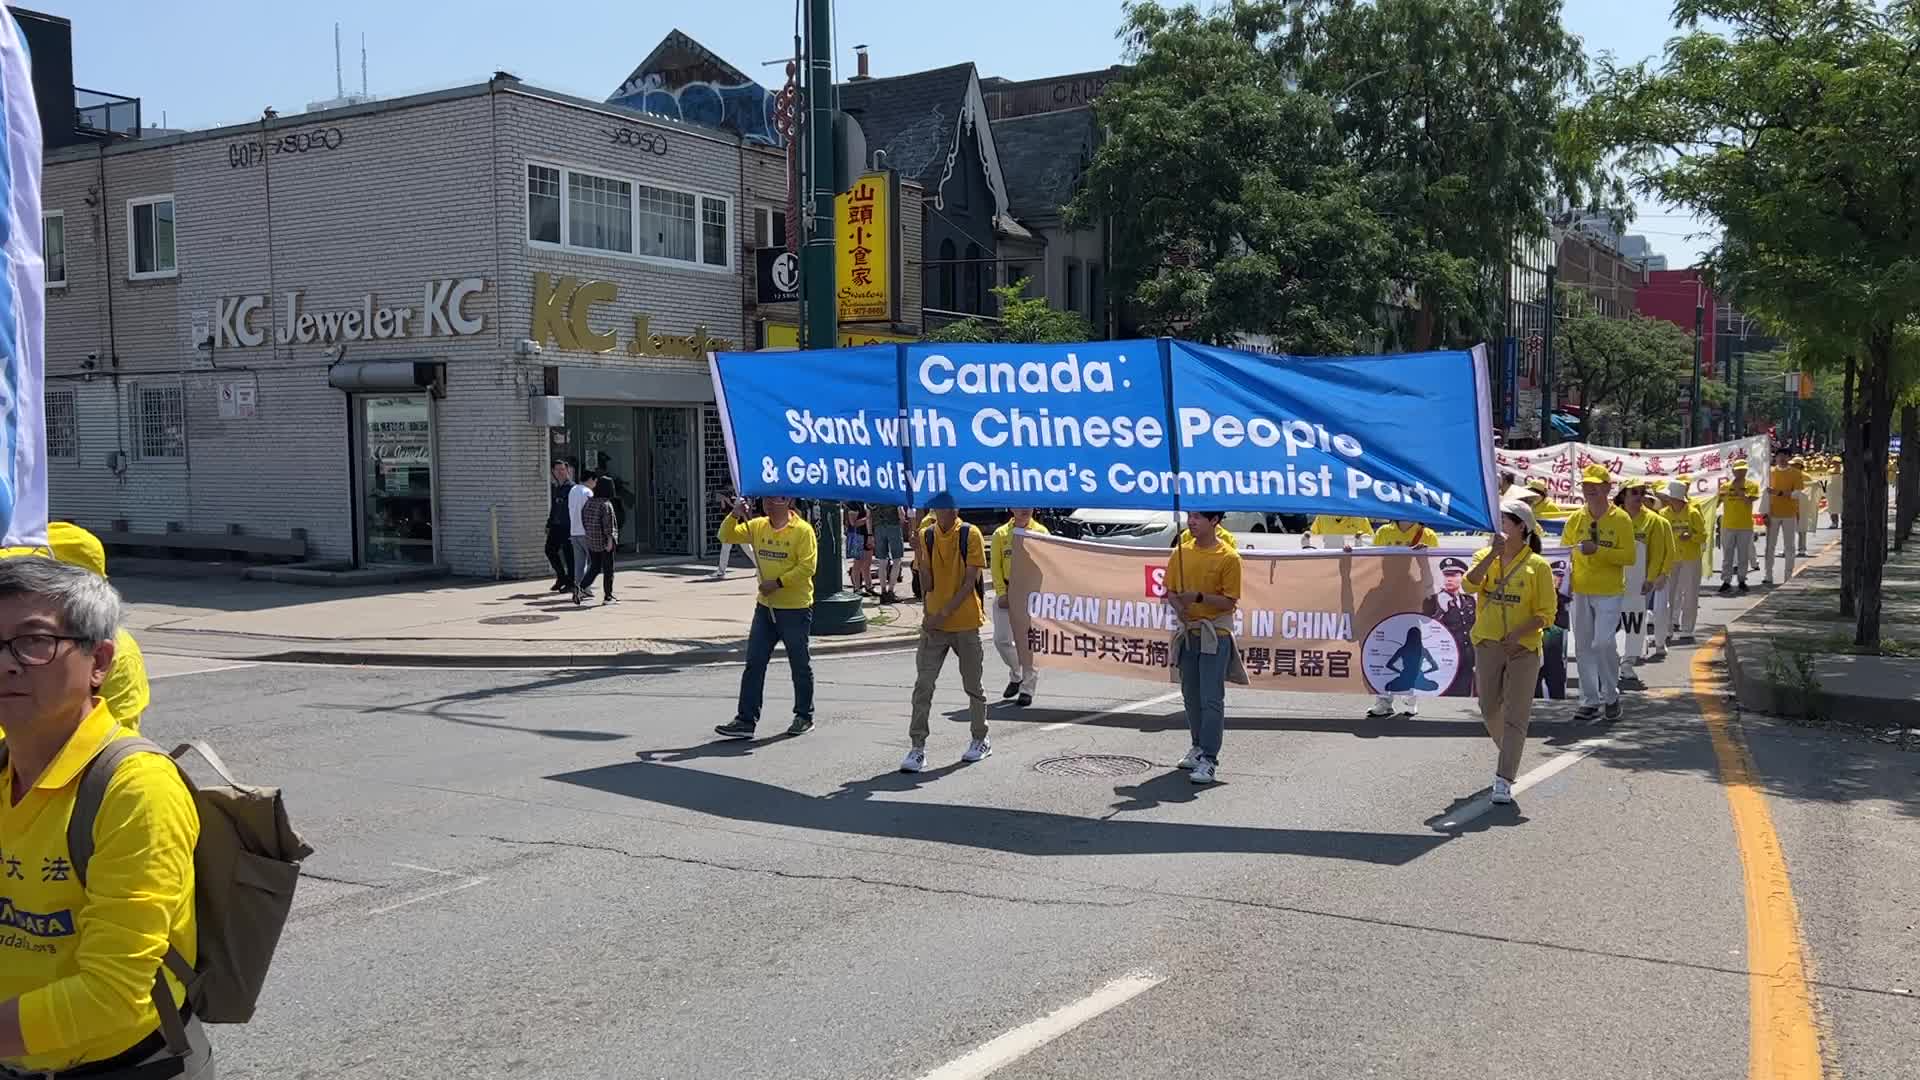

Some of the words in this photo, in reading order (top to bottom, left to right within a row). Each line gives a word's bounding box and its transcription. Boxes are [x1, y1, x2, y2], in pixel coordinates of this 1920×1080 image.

[847, 183, 875, 286] 汕頭小食家
[214, 296, 265, 348] KC
[274, 291, 411, 344] Jeweler
[423, 278, 484, 337] KC
[531, 272, 618, 353] KC
[918, 353, 1132, 395] Canada:
[785, 409, 871, 446] Stand
[875, 408, 957, 448] with
[971, 407, 1163, 449] Chinese
[762, 457, 780, 484] &
[786, 456, 829, 484] Get
[834, 458, 871, 488] Rid
[876, 461, 894, 490] of
[958, 461, 1098, 493] China's
[1107, 462, 1333, 497] Communist
[1346, 467, 1452, 516] Party
[1027, 591, 1101, 625] ORGAN
[1251, 609, 1275, 638] IN
[1281, 610, 1353, 641] CHINA
